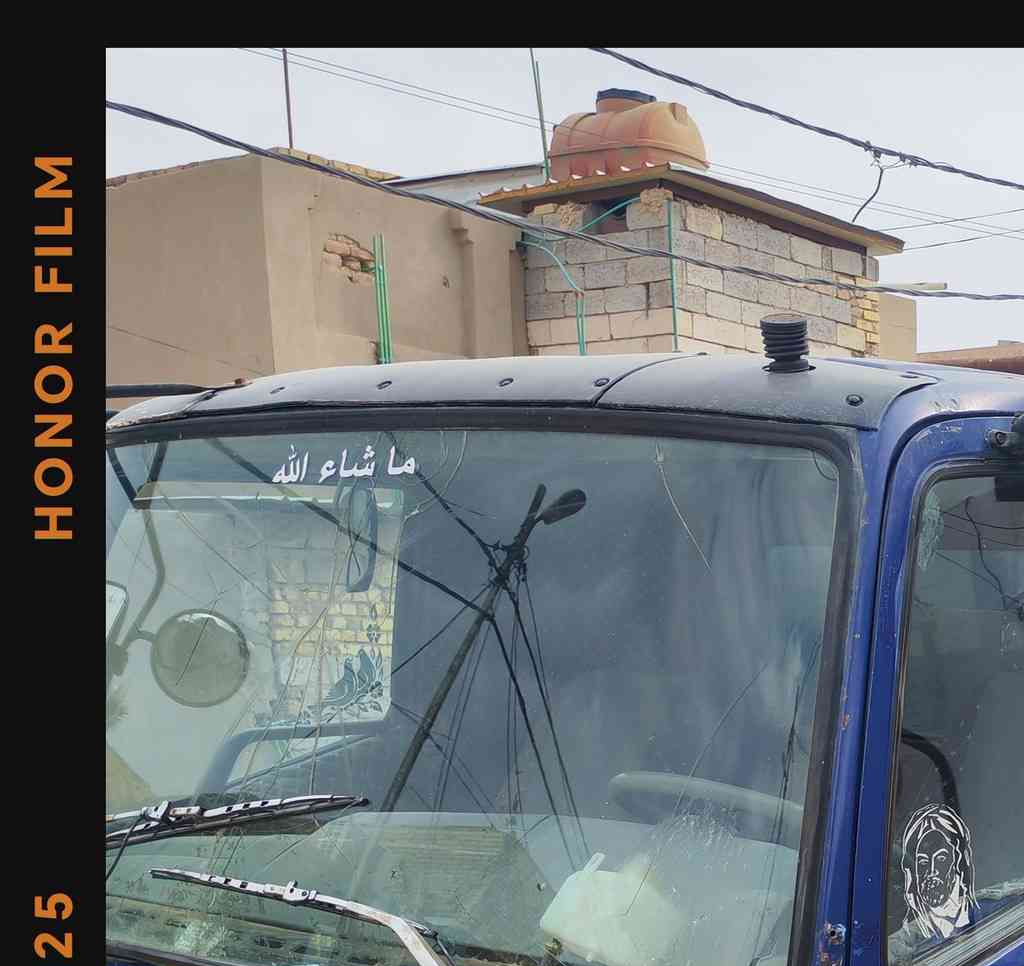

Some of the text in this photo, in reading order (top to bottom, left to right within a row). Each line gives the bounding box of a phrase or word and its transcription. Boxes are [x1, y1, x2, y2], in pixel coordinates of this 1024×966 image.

[272, 444, 416, 484] ما شاء الله
